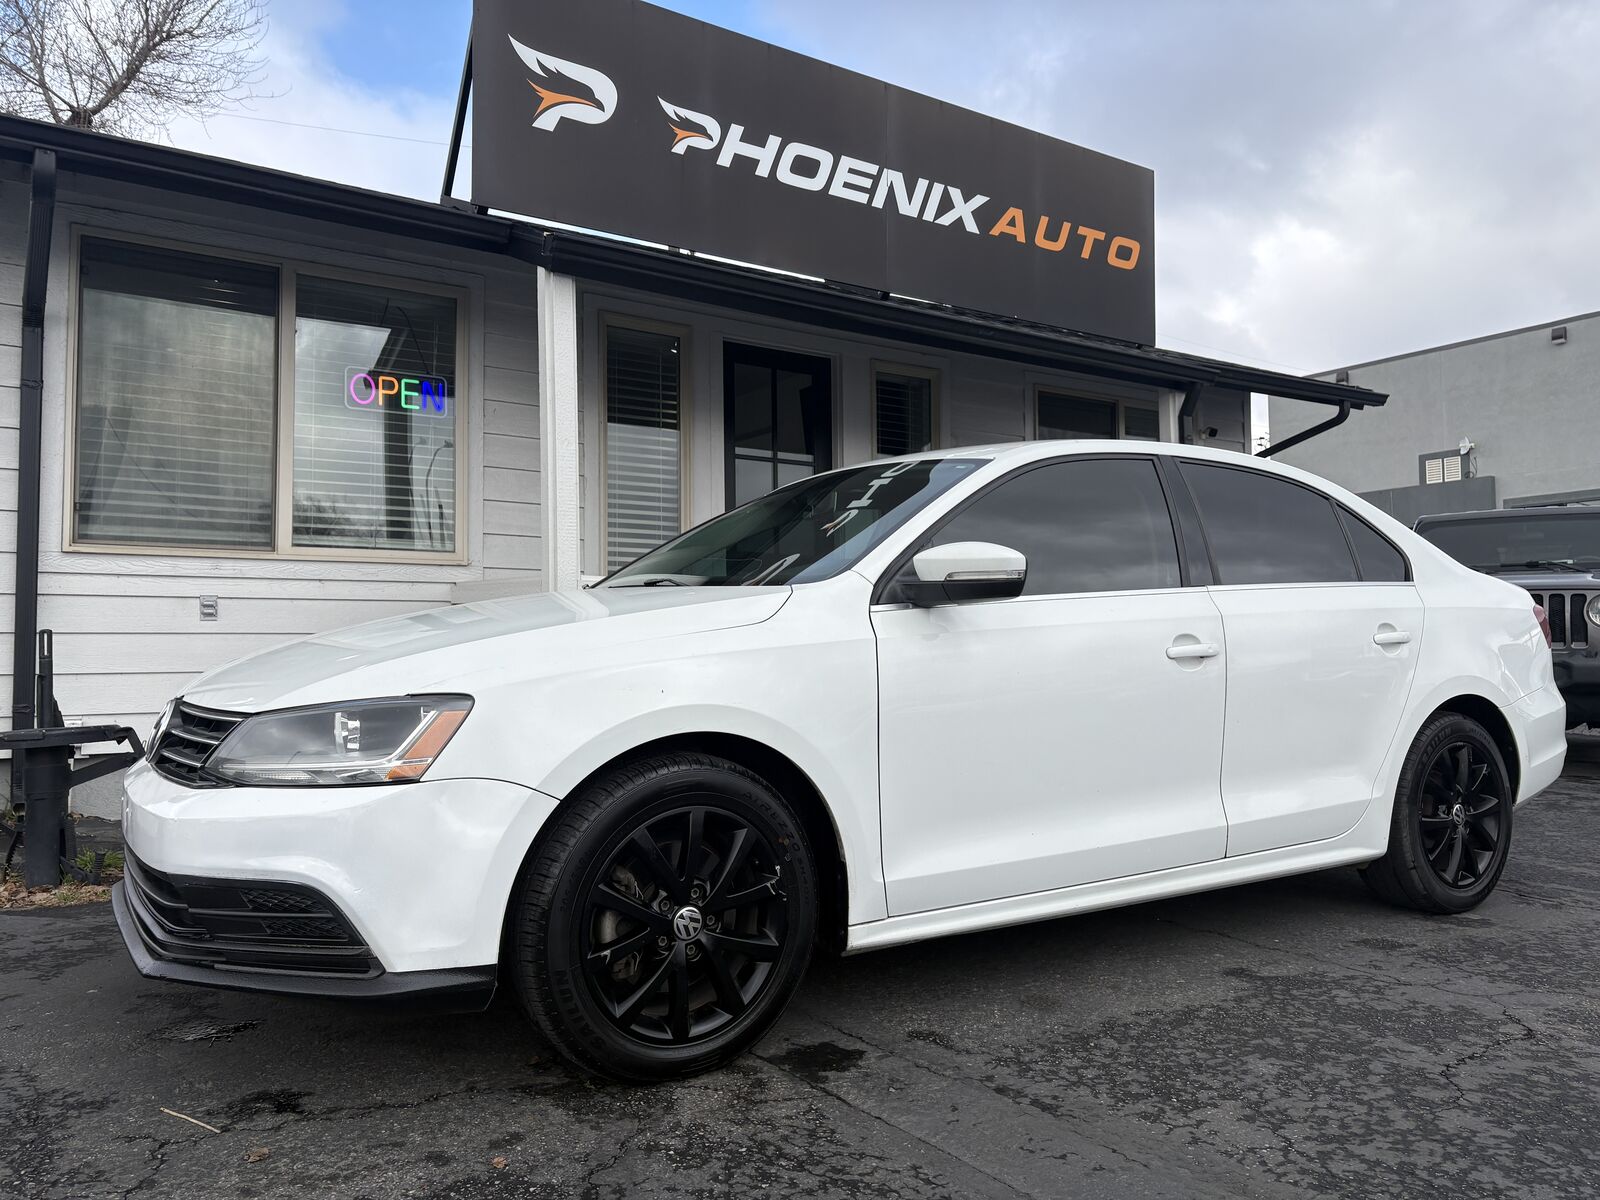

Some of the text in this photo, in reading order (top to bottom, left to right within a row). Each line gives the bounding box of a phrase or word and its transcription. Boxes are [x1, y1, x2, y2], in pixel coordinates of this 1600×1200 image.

[657, 96, 1141, 270] PHOENIX AUTO
[350, 373, 443, 413] OPEN
